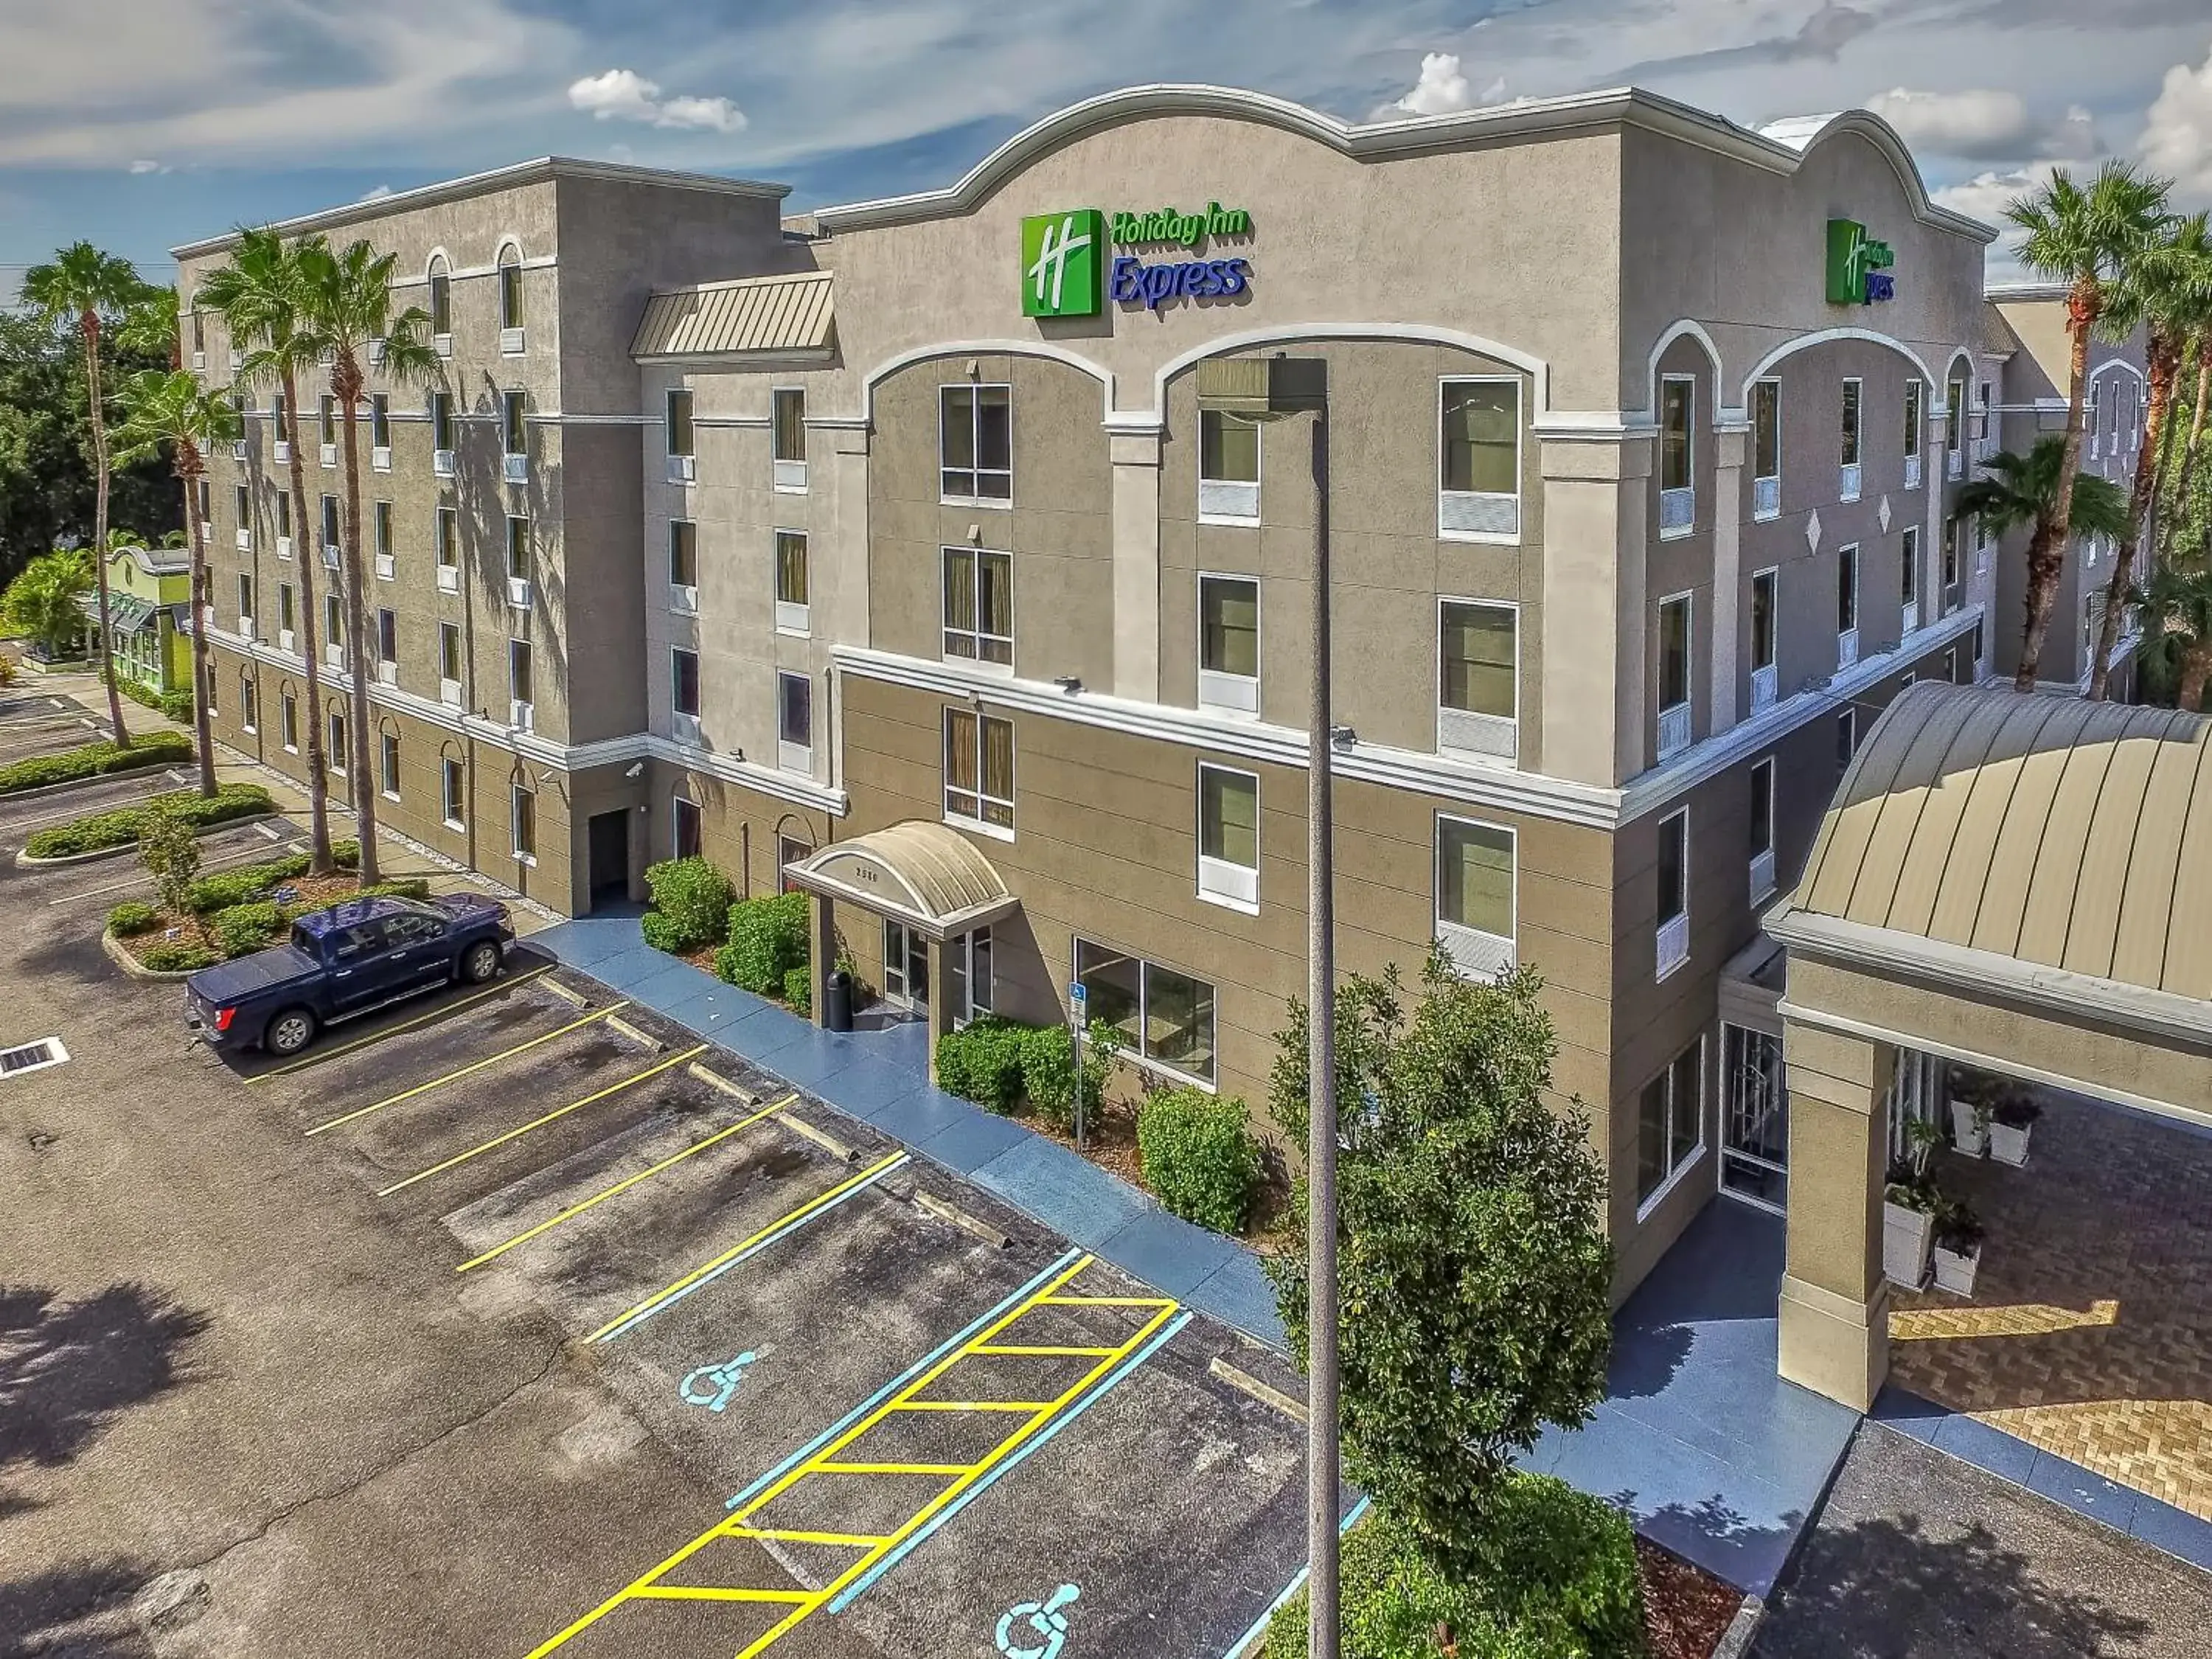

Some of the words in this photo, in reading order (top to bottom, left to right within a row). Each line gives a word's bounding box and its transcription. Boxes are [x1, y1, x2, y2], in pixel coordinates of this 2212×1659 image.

[1110, 208, 1202, 246] Holiday
[1203, 201, 1250, 234] Inn
[1110, 257, 1245, 310] Express
